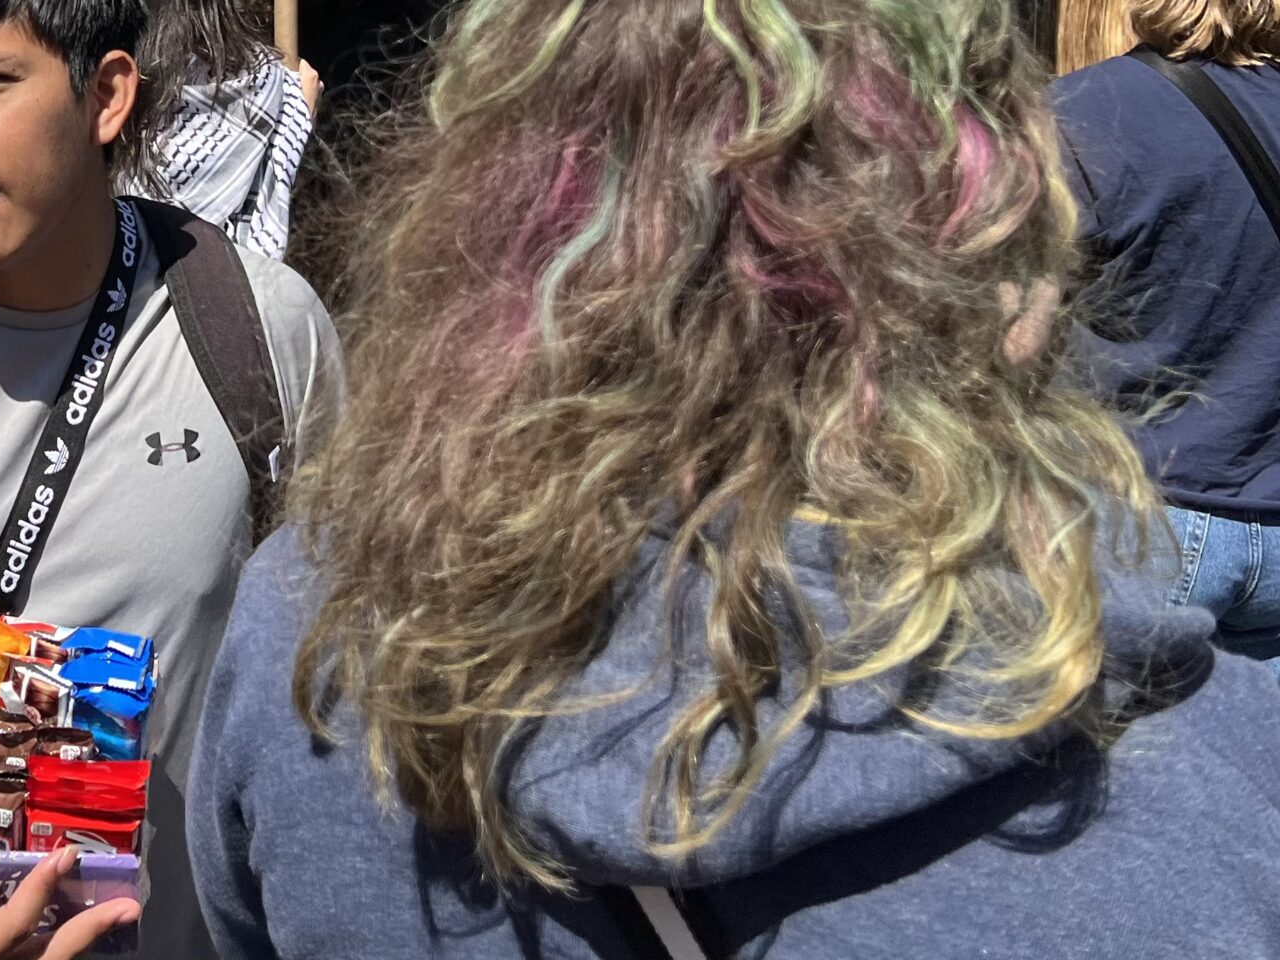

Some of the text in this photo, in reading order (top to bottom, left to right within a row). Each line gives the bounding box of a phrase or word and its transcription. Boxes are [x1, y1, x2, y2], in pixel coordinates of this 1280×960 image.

[118, 200, 138, 268] adida
[65, 323, 116, 426] adidas
[0, 484, 54, 594] adidas
